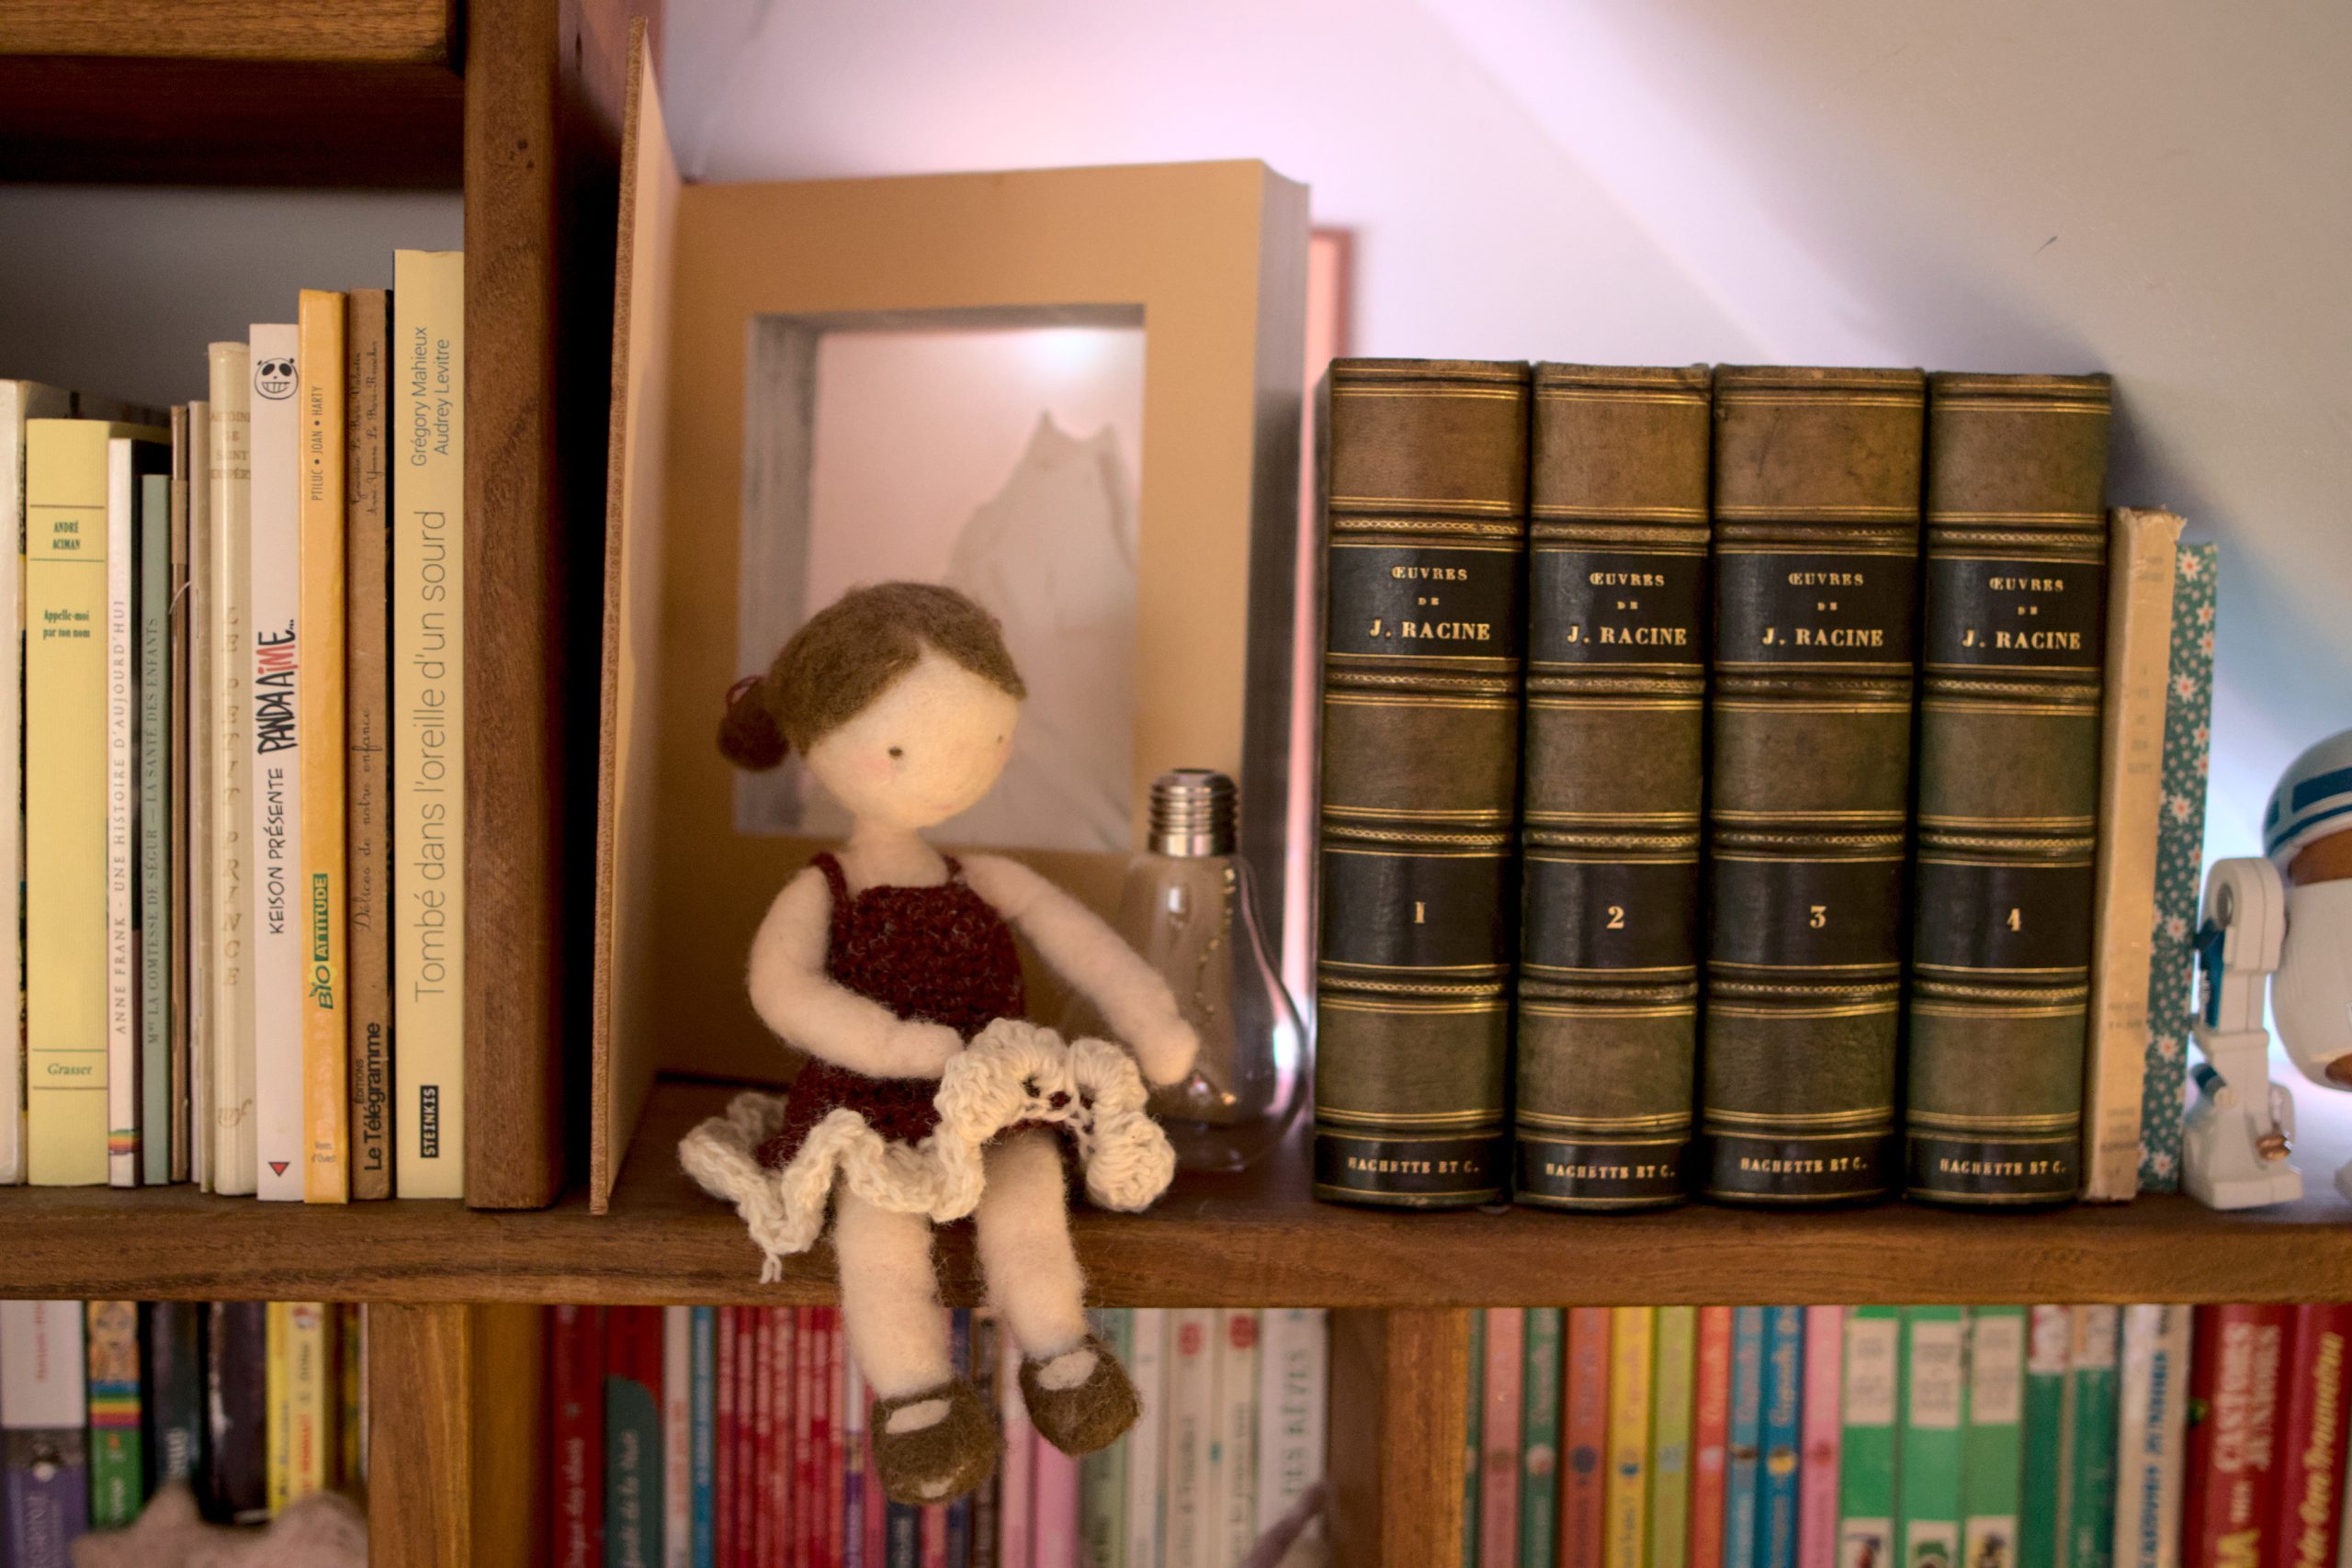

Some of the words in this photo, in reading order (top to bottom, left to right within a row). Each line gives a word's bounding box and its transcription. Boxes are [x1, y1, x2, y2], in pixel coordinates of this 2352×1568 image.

[411, 327, 427, 397] Mahieux
[434, 339, 450, 393] Levitre
[311, 386, 323, 415] HARTY
[411, 401, 430, 467] Grégory
[434, 399, 453, 456] Audrey
[311, 430, 323, 455] JOAN
[311, 469, 323, 501] PTILUC
[53, 520, 79, 533] ANDRÉ
[51, 539, 81, 549] ACIMAN
[413, 511, 446, 602] sourd
[1391, 566, 1468, 581] ŒUVRES
[1589, 571, 1665, 587] ŒUVRES
[1788, 572, 1865, 586] ŒUVRES
[1988, 577, 2065, 592] ŒUVRES
[1418, 597, 1440, 606] DE
[1617, 601, 1639, 610] DE
[44, 610, 90, 623] Appelle-moi
[1369, 618, 1392, 637] J.
[1401, 621, 1490, 641] RACINE
[42, 626, 57, 638] par
[59, 625, 72, 637] ton
[73, 627, 90, 637] nom
[1566, 625, 1589, 644] J.
[1600, 626, 1688, 646] RACINE
[1762, 626, 1786, 647] J.
[1795, 628, 1884, 648] RACINE
[1962, 630, 1986, 649] J.
[1996, 631, 2082, 650] RACINE
[146, 617, 158, 687] ENFANTS
[413, 613, 446, 680] d'un
[112, 600, 127, 748] D'AUJOURD'HUI
[145, 693, 158, 722] DES
[255, 691, 298, 754] PANDA
[143, 728, 158, 777] SANTÉ
[351, 709, 382, 773] enfance
[413, 689, 446, 792] l'oreille
[114, 759, 125, 845] HISTOIRE
[145, 784, 157, 802] LA
[356, 784, 371, 825] notre
[264, 768, 286, 860] PRÉSENTE
[144, 829, 158, 880] SÉGUR
[357, 838, 371, 856] de
[413, 803, 446, 880] dans
[114, 856, 125, 891] UNE
[147, 886, 158, 905] DE
[267, 867, 285, 934] KEISON
[351, 867, 372, 931] Délices
[314, 874, 329, 960] ATTITUDE
[1414, 902, 1426, 924] 1
[1606, 906, 1624, 930] 2
[1810, 906, 1826, 929] 3
[2007, 908, 2021, 931] 4
[114, 918, 126, 976] FRANK
[146, 911, 158, 990] COMTESSE
[413, 889, 446, 1003] Tombé
[114, 986, 126, 1034] ANNE
[147, 996, 158, 1015] LA
[46, 1062, 93, 1077] Grasset
[363, 1022, 386, 1144] Télégramme
[423, 1087, 437, 1156] STEINKIS
[364, 1147, 382, 1171] Le
[1347, 1156, 1431, 1174] HACHETTE
[1545, 1163, 1629, 1179] HACHETTE
[1740, 1157, 1823, 1174] HACHETTE
[1939, 1157, 2022, 1176] HACHETTE
